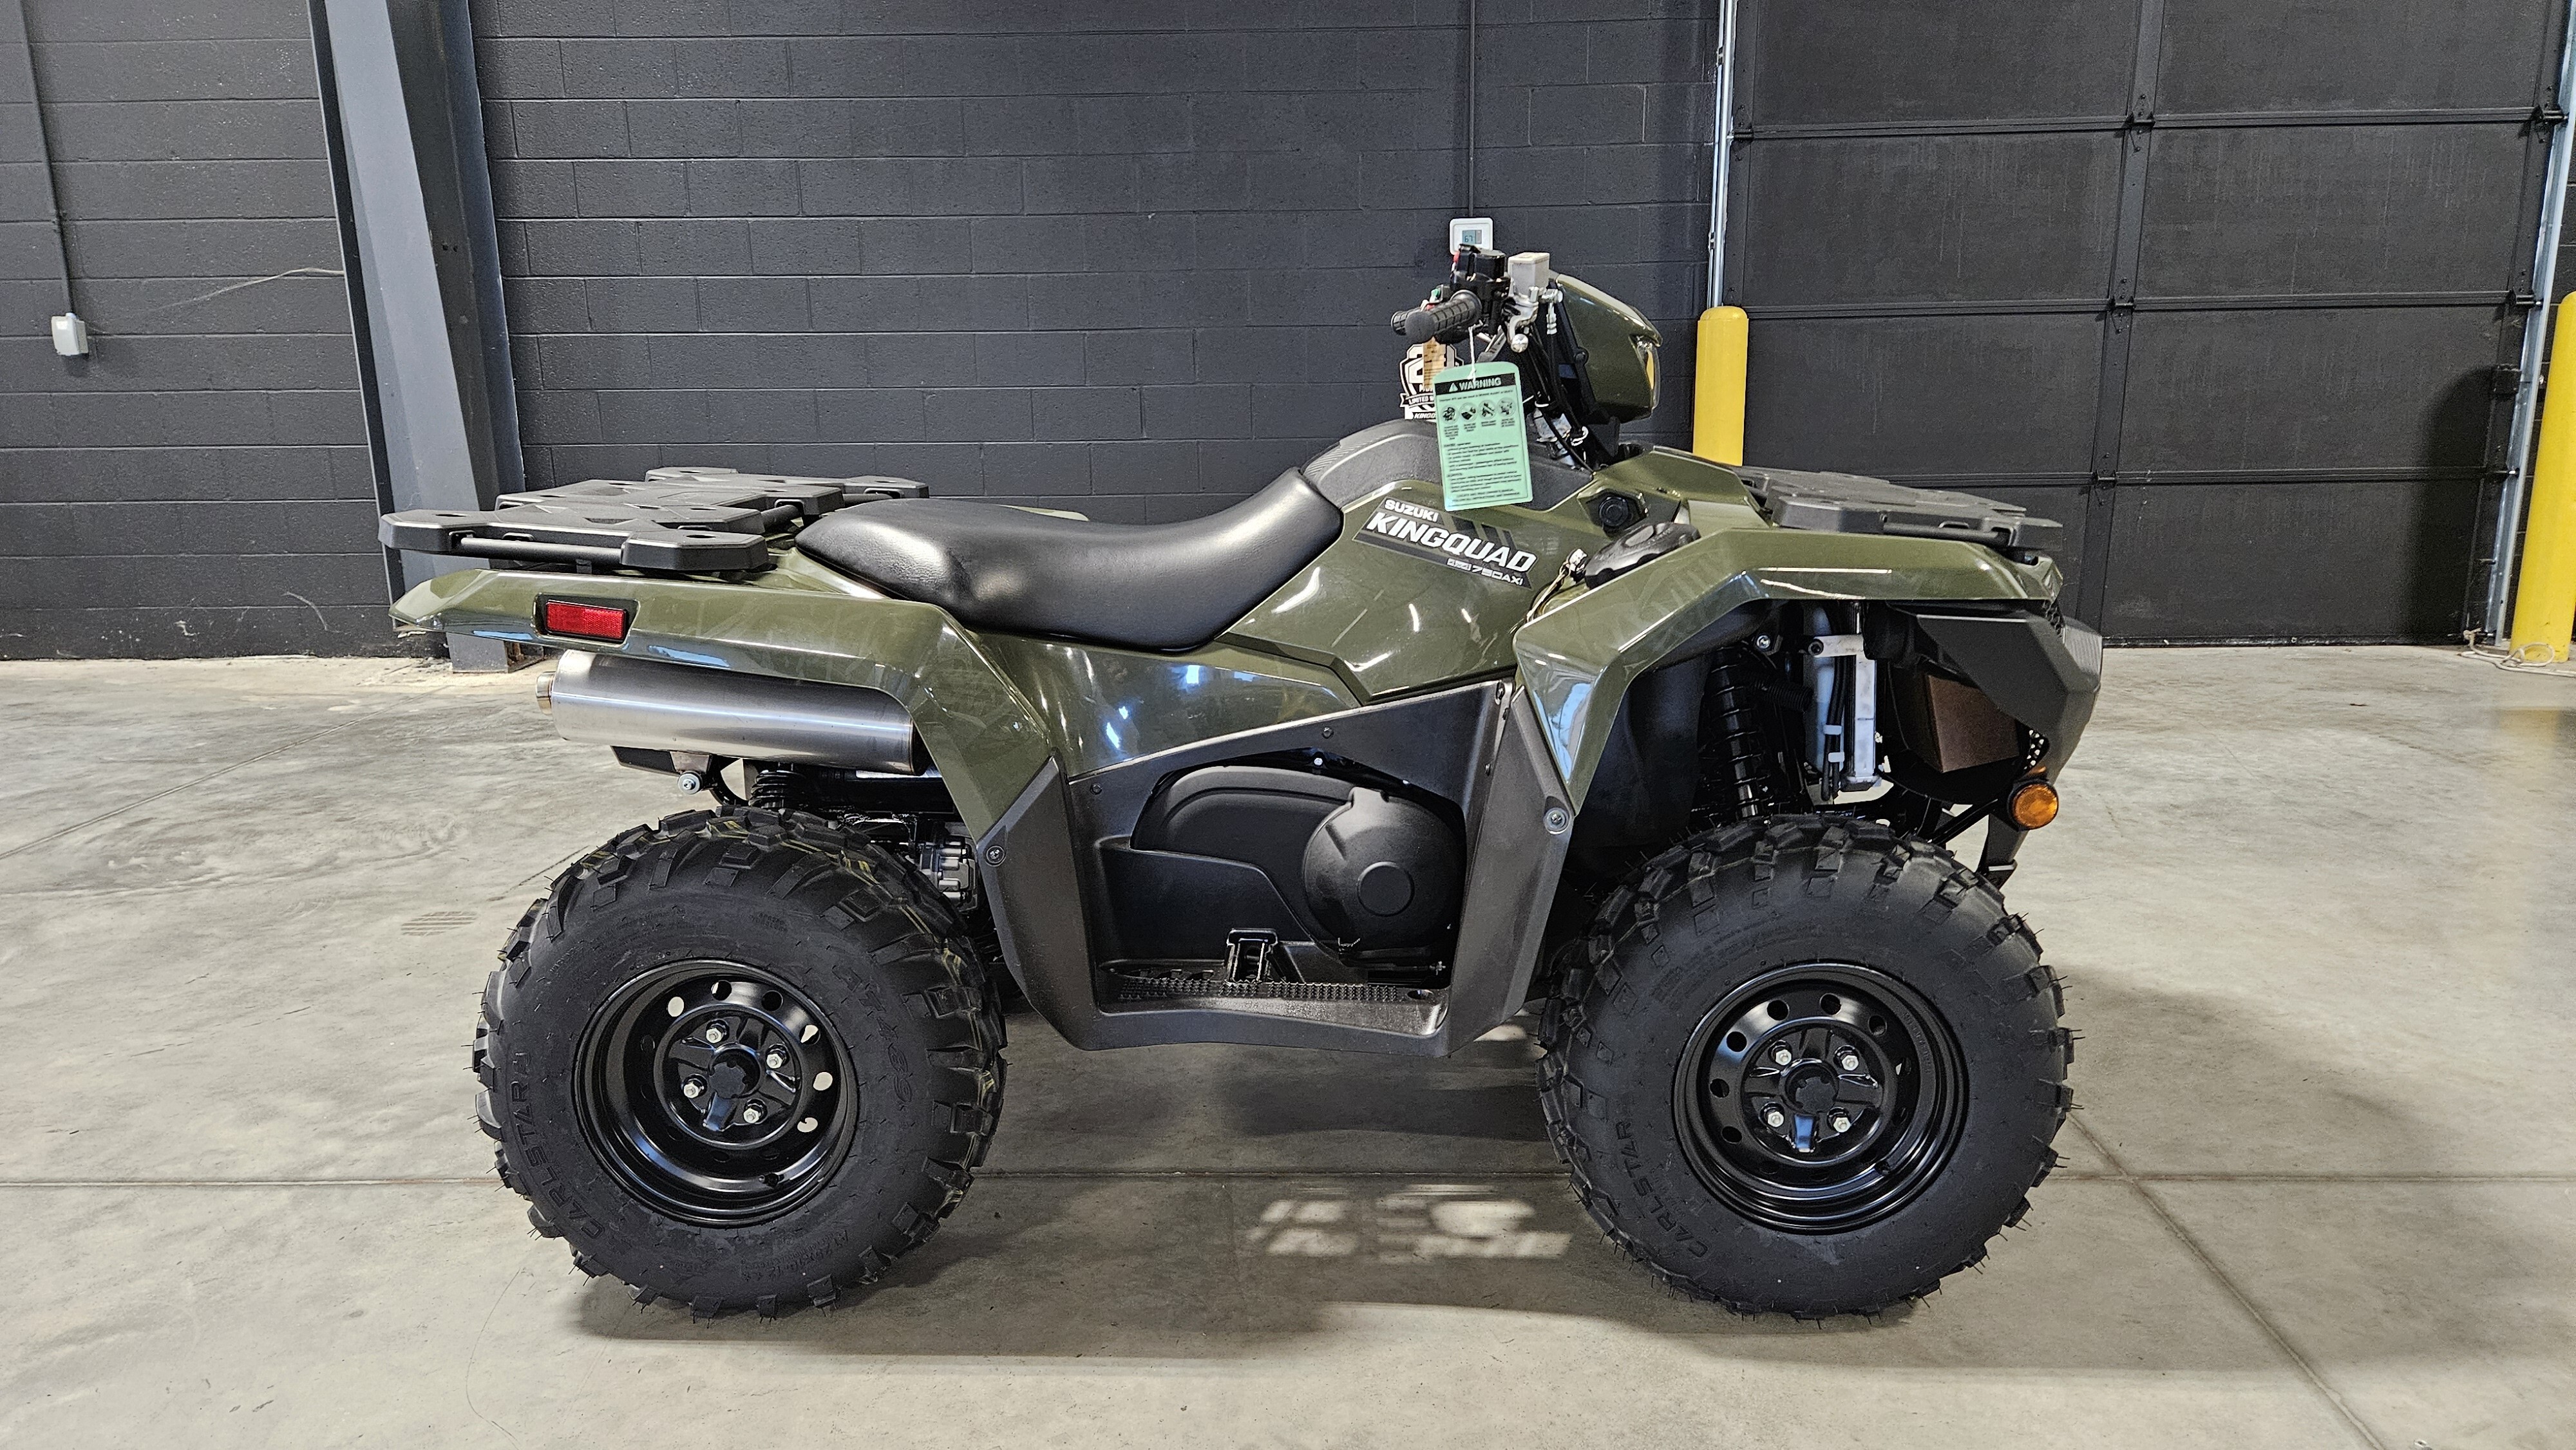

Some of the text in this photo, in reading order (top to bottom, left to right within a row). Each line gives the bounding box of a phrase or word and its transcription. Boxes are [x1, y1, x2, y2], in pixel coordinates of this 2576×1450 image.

[1459, 377, 1502, 391] WARNING
[1385, 498, 1439, 522] SUZUKI
[1366, 512, 1537, 572] KINGQUAD
[511, 1080, 605, 1239] CARLSTAR
[1615, 1121, 1709, 1258] CARLSTAR
